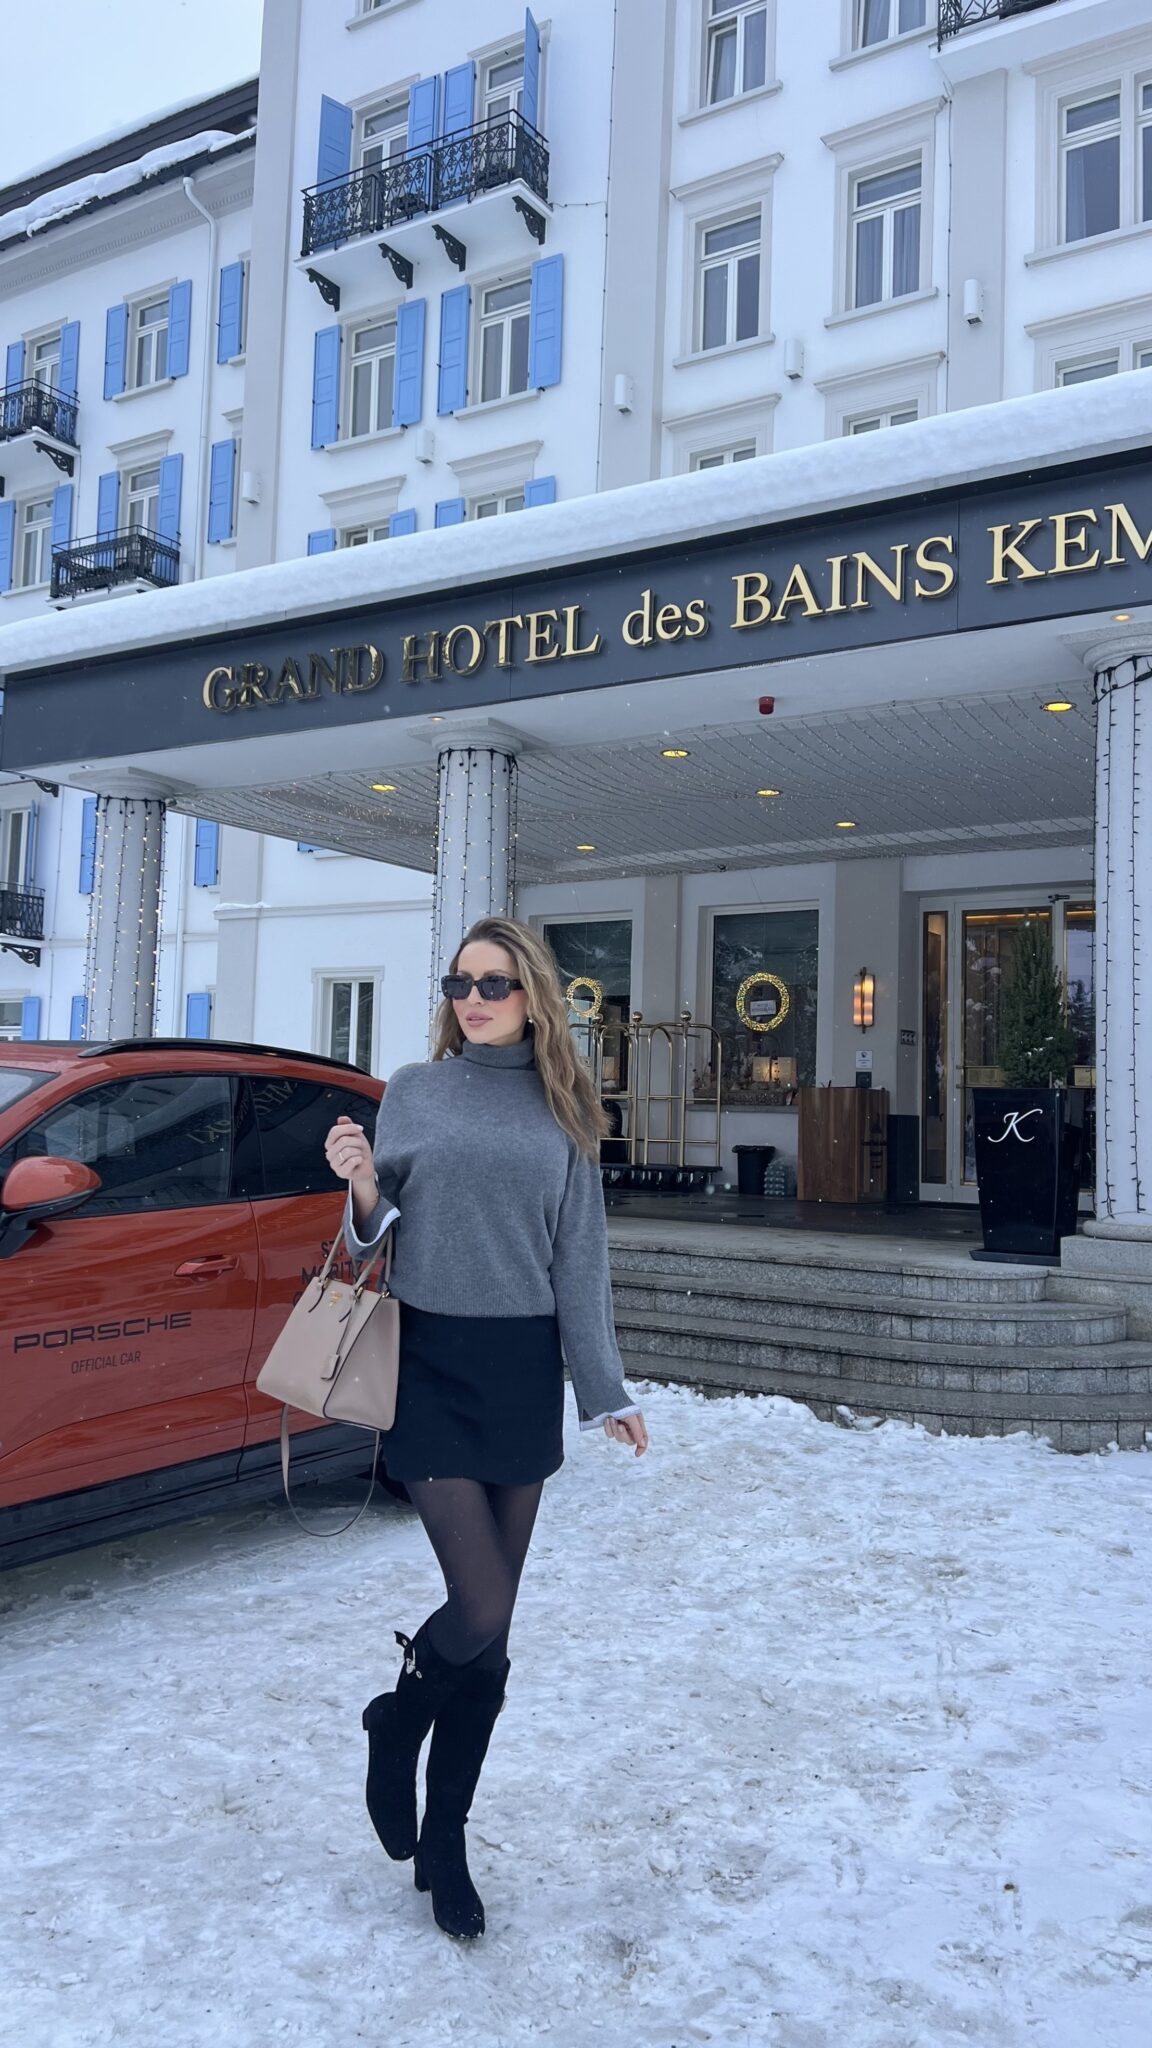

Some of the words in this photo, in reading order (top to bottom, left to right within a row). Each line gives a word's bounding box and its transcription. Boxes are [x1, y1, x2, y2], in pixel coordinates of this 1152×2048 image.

[202, 643, 384, 713] GRAND
[401, 605, 602, 683] HOTEL
[621, 589, 707, 648] des
[730, 535, 958, 630] BAINS
[986, 502, 1152, 586] KEM
[987, 1108, 1043, 1143] K
[13, 1311, 192, 1354] PORSCHE
[71, 1355, 118, 1375] OFFICIAL
[120, 1350, 142, 1366] CAR
